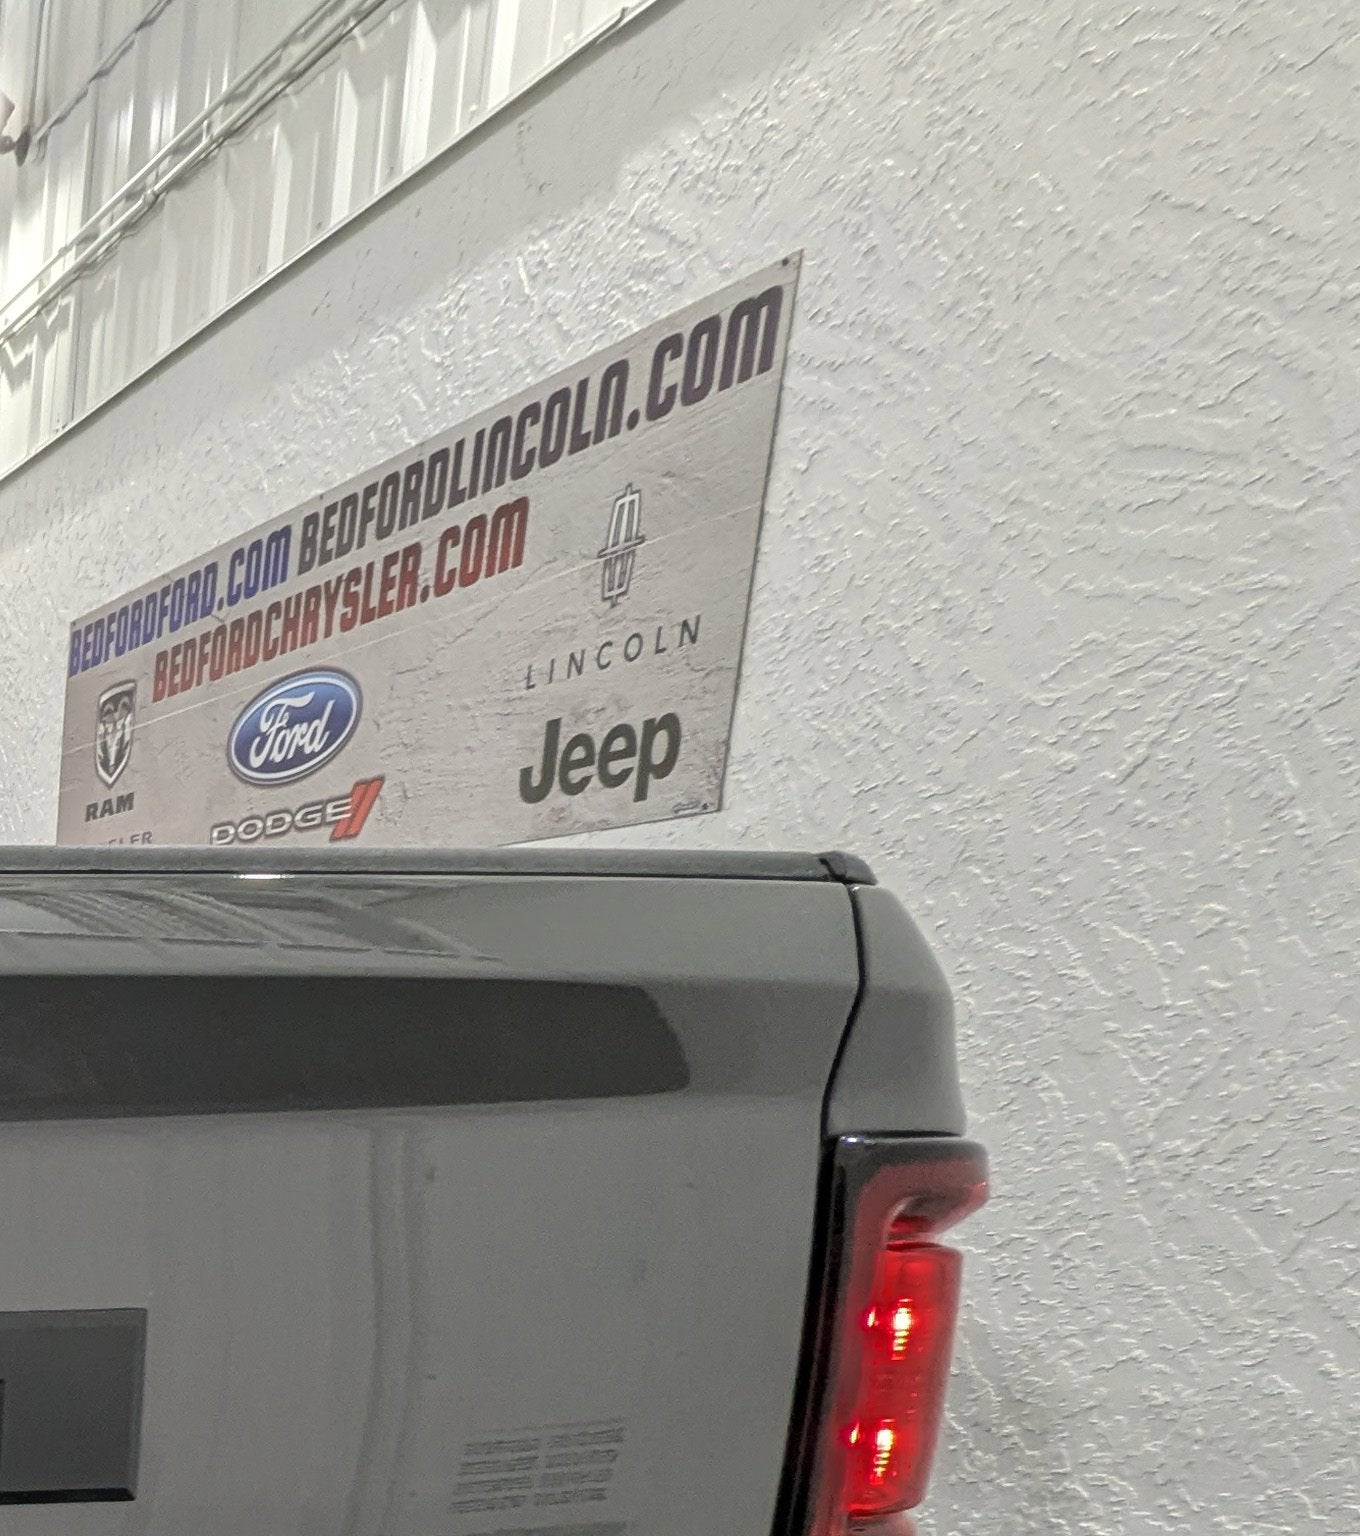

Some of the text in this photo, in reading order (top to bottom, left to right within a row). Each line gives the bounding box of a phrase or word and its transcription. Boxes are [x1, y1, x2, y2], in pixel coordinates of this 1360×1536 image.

[69, 284, 784, 678] BEDFORDFORD.COM BEDFORDLINCOLN.COM
[151, 496, 529, 702] BEDFORDCHRYSLER.COM
[525, 614, 701, 690] LINCOLN
[248, 690, 335, 768] Ford
[519, 712, 682, 803] Jeep
[84, 792, 134, 822] RAM
[210, 797, 353, 846] DODGE
